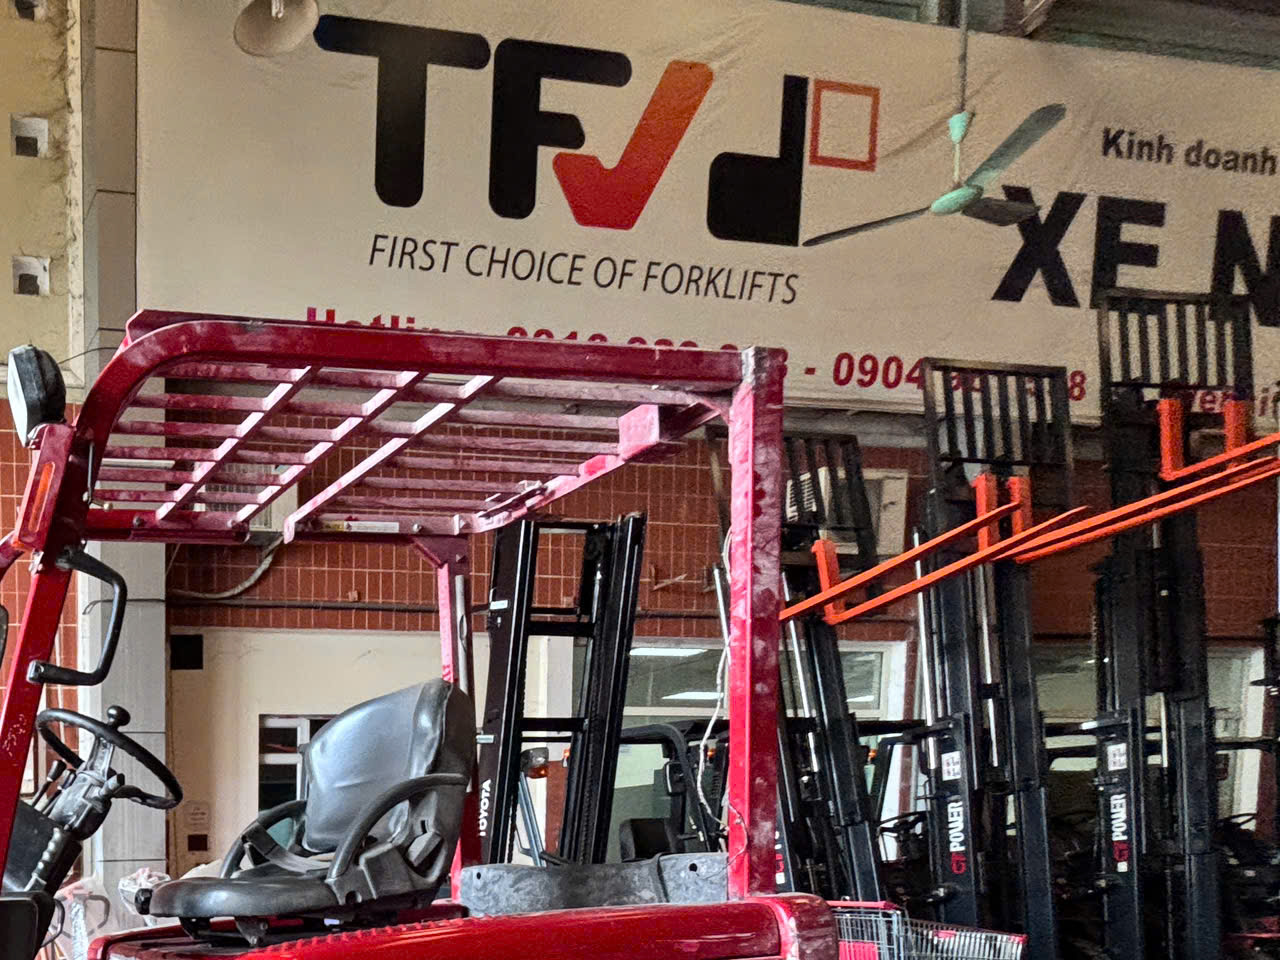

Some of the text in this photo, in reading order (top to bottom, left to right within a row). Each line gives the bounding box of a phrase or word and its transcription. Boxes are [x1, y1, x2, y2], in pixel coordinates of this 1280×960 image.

[1101, 127, 1277, 176] Kinh doanh
[368, 233, 799, 305] FIRST CHOICE OF FORKLIFTS
[990, 184, 1167, 310] XE
